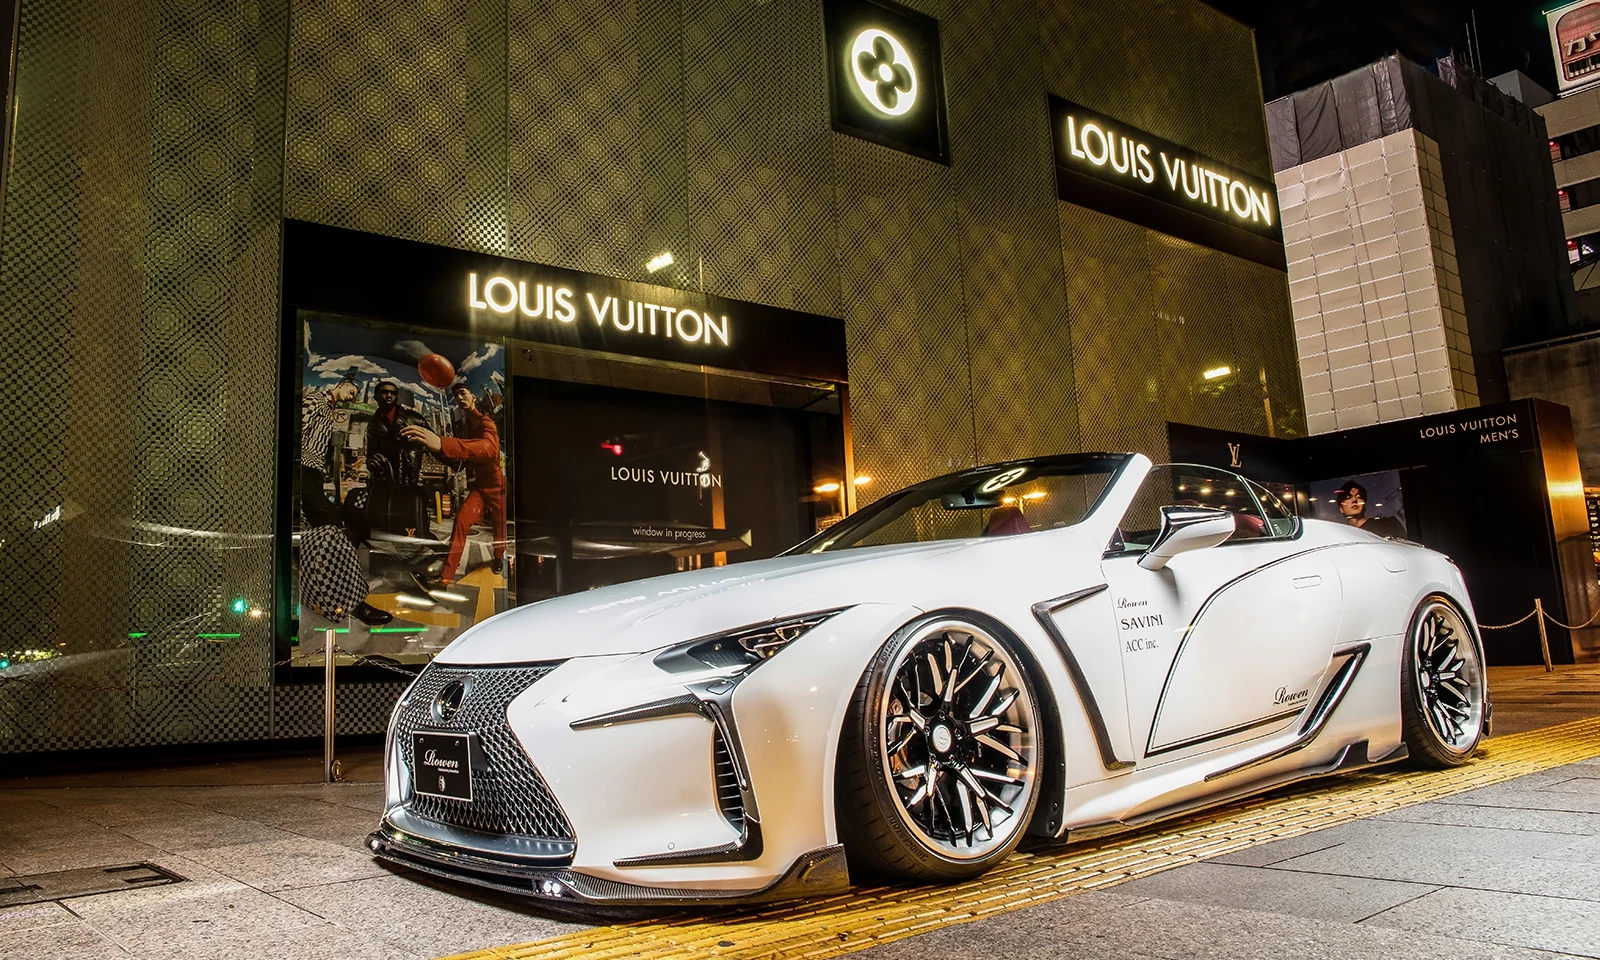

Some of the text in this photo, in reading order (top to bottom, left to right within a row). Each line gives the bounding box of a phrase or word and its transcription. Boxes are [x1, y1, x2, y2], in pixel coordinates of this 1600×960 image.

[1067, 115, 1272, 226] LOUIS VUITTON
[469, 273, 729, 346] LOUIS VUITTON
[1420, 413, 1517, 439] LOUIS VUITTON
[1480, 429, 1519, 444] MEN'S
[611, 466, 722, 488] LOUIS VUITTON
[632, 526, 706, 540] window in progress
[1117, 597, 1148, 609] Rowen
[1120, 613, 1164, 631] SAVINI
[1125, 637, 1159, 653] ACC inc.
[1272, 684, 1309, 706] Rowen
[423, 749, 459, 768] Rowen
